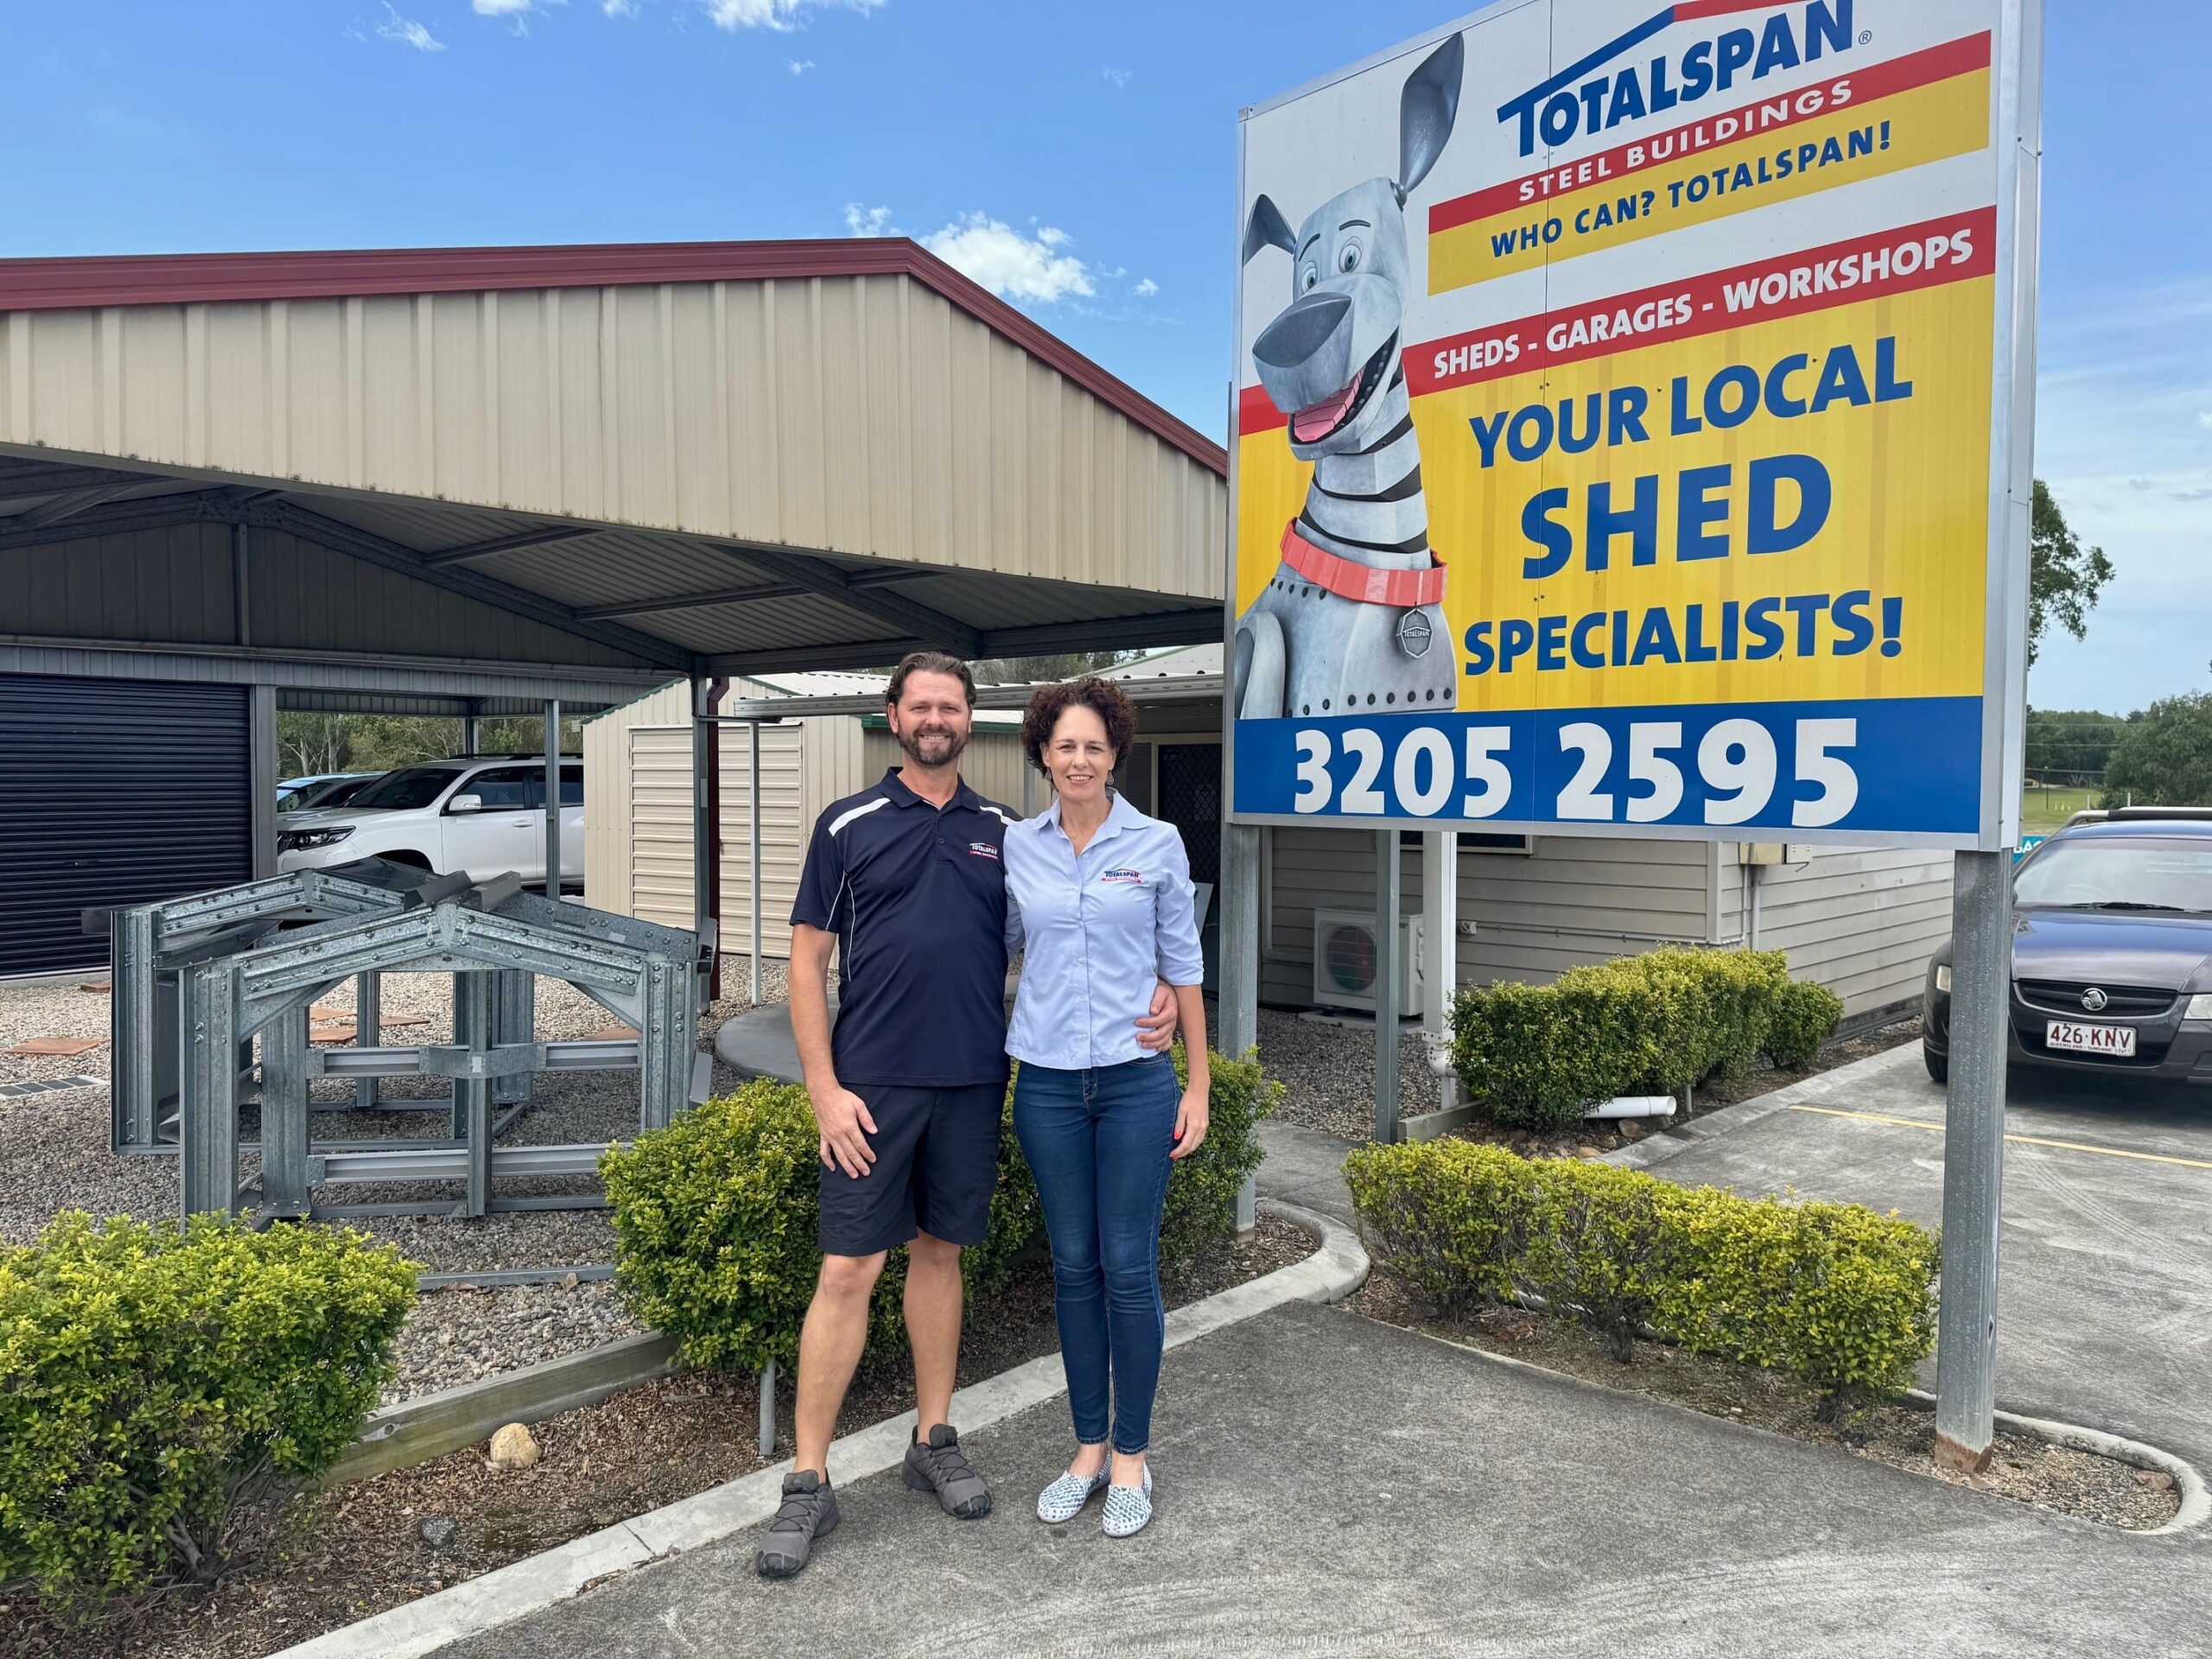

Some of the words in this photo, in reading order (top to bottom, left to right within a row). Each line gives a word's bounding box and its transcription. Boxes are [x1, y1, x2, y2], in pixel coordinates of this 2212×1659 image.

[1497, 0, 1853, 157] TOTALSPAN
[1519, 157, 1611, 201] STEEL
[1627, 79, 1852, 168] BUILDINGS
[1492, 219, 1562, 257] WHO
[1575, 192, 1654, 232] CAN?
[1669, 123, 1889, 206] TOTALSPAN!
[1433, 334, 1520, 378] SHEDS
[1546, 293, 1693, 352] GARAGES
[1722, 228, 1974, 313] WORKSHOPS
[1471, 387, 1648, 467] YOUR
[1671, 338, 1912, 435] LOCAL
[1522, 455, 1831, 579] SHED
[1403, 627, 1431, 638] TOTALSPAN
[1465, 591, 1902, 675] SPECIALISTS!
[1294, 726, 1512, 818] 3205
[1556, 718, 1859, 827] 2595
[1103, 869, 1140, 878] TOTALSPAN
